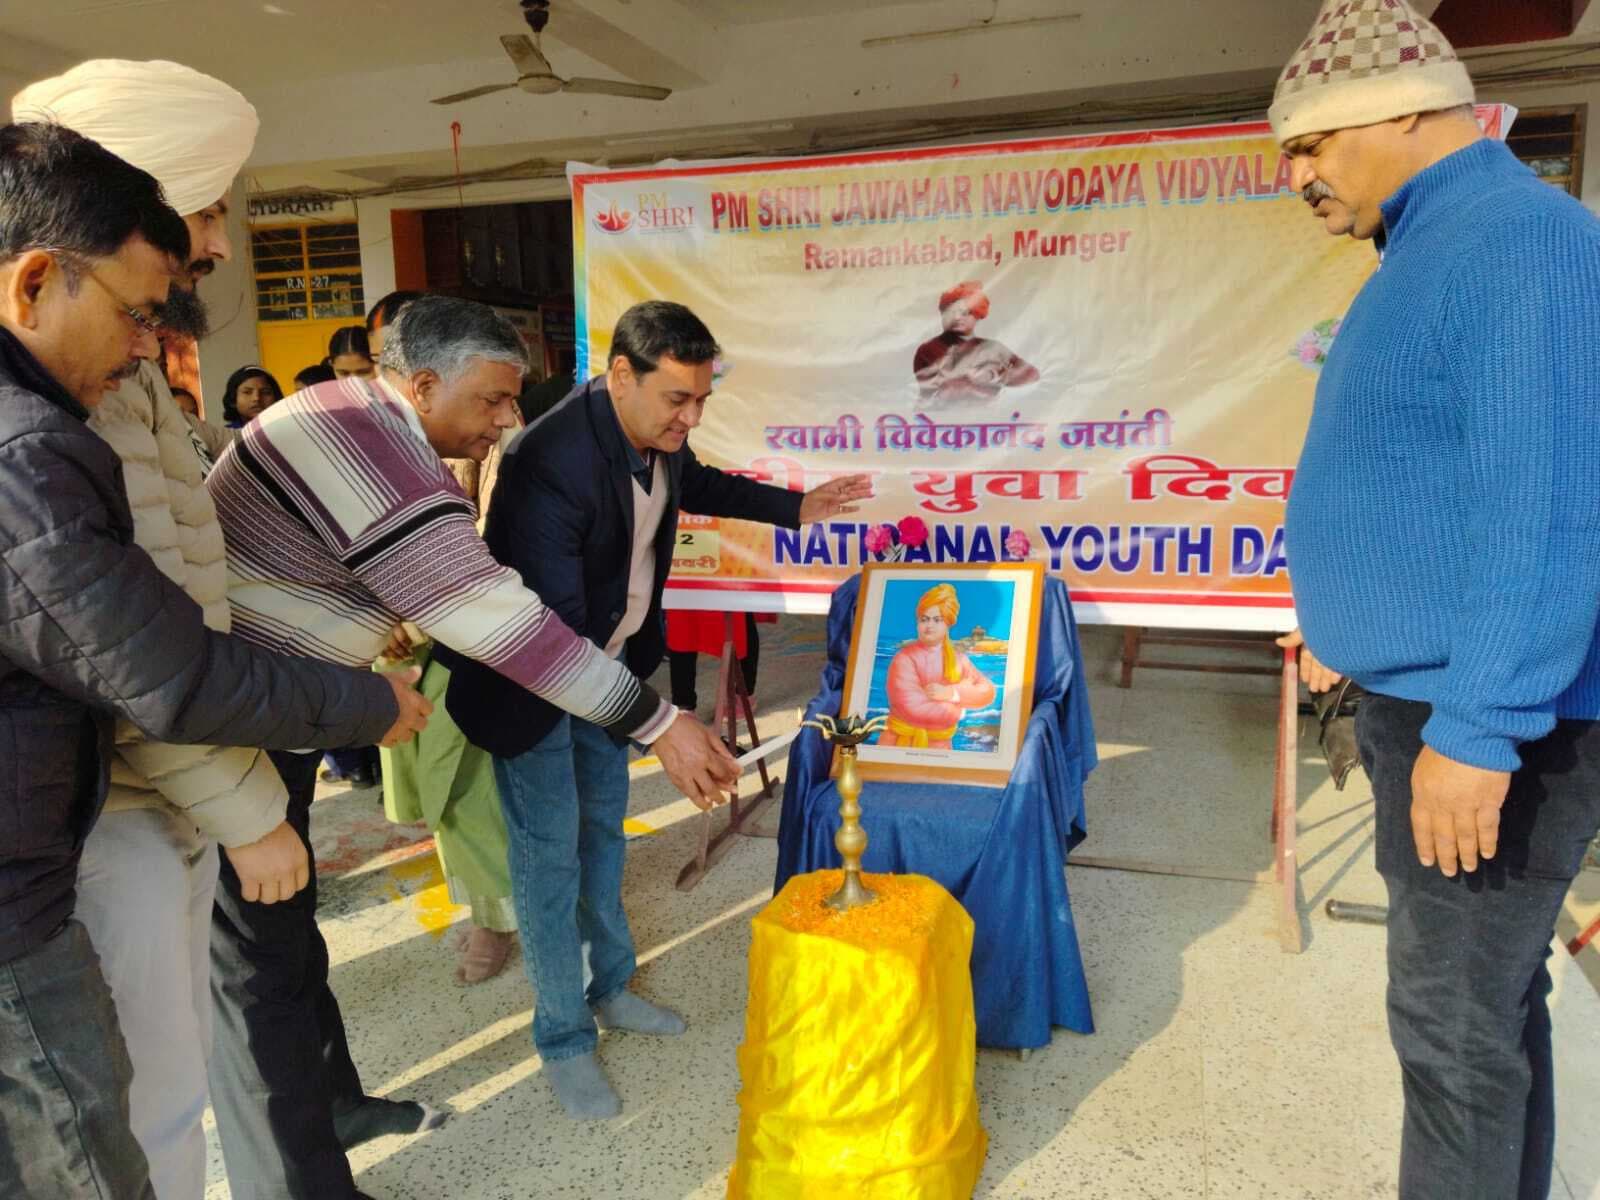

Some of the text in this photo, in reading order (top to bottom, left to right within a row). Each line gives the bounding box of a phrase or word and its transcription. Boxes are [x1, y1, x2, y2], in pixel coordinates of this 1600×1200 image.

[711, 153, 1293, 229] PM SHRI JAWAHAR NAVODAYA VIDYALA
[638, 206, 695, 227] SHRI
[804, 229, 1131, 270] Ramankabad, Munger
[765, 408, 1174, 450] स्वामी विवेकानंद जयंती
[913, 470, 1088, 514] युवा
[1122, 455, 1295, 500] दिव
[1041, 526, 1212, 574] YOUTH
[1231, 526, 1288, 575] DA
